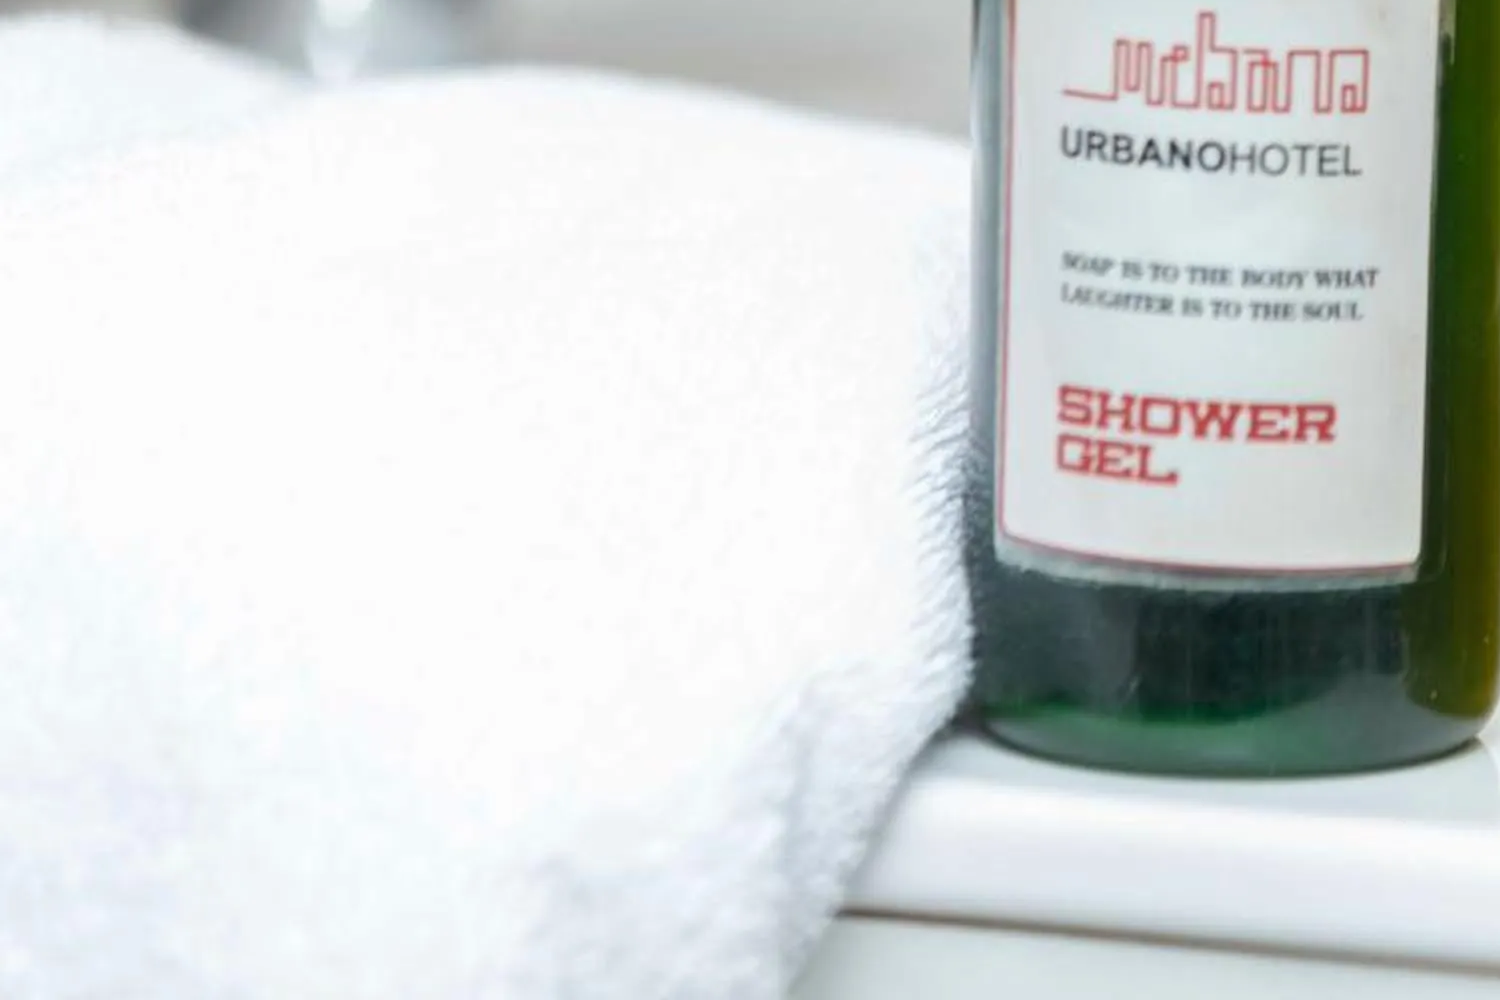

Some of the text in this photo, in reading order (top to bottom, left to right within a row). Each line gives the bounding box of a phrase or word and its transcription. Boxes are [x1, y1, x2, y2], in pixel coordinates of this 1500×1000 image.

[1060, 126, 1362, 177] URBANOHOTEL
[1061, 250, 1380, 290] SOAP IS TO THE BODY WHAT
[1061, 282, 1365, 322] LAUGHTER IS TO THE SOUL
[1057, 383, 1338, 443] SHOWER
[1055, 433, 1179, 486] GEL
